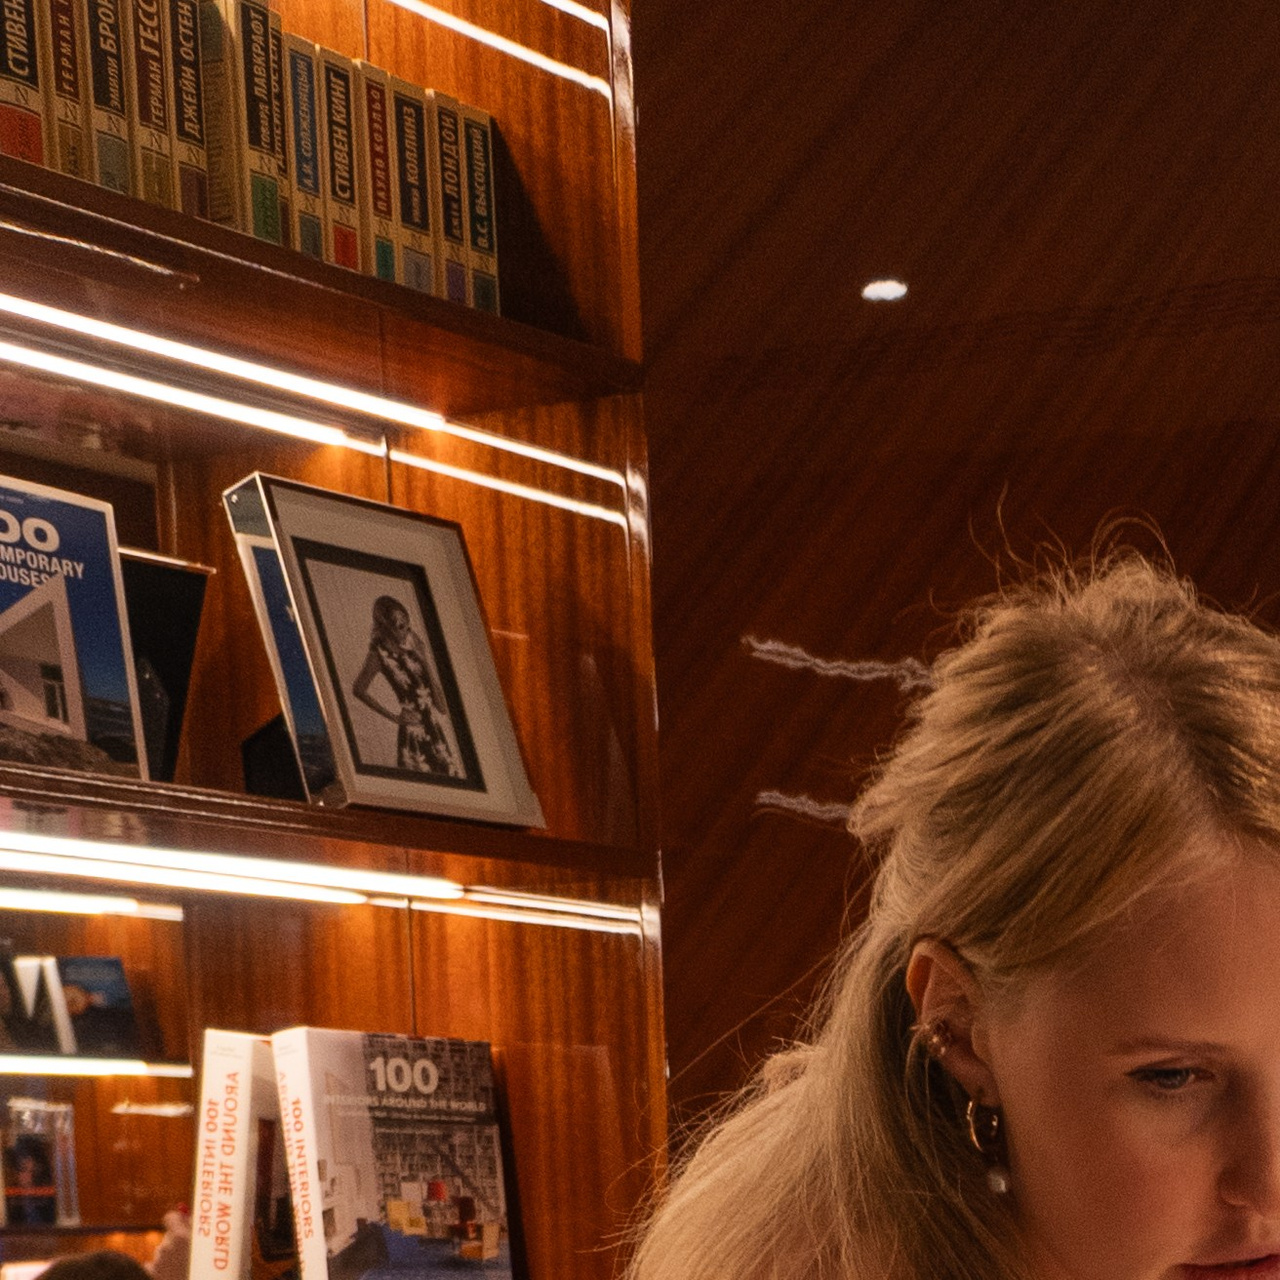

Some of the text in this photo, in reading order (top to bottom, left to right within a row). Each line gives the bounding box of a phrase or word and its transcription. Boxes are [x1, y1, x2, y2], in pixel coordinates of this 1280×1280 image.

[57, 12, 75, 93] ГЕРМАН
[148, 59, 166, 128] ГЕРМАН
[177, 1, 202, 140] ДЖЕЙН ОСТЕН
[250, 9, 268, 102] ЛАВКРАФТ
[296, 59, 313, 158] СОЛЖЕНИЦЫН
[329, 71, 350, 199] СТИВЕН КИНГ
[370, 87, 388, 211] ПАУЛО КОЭЛЬО
[403, 106, 419, 186] КОЛЛИНЗ
[441, 114, 459, 199] ЛОНДОН
[471, 128, 487, 218] ВЫСОЦКИЙ
[369, 1056, 439, 1095] 100
[291, 1097, 314, 1240] 100 INTERIORS
